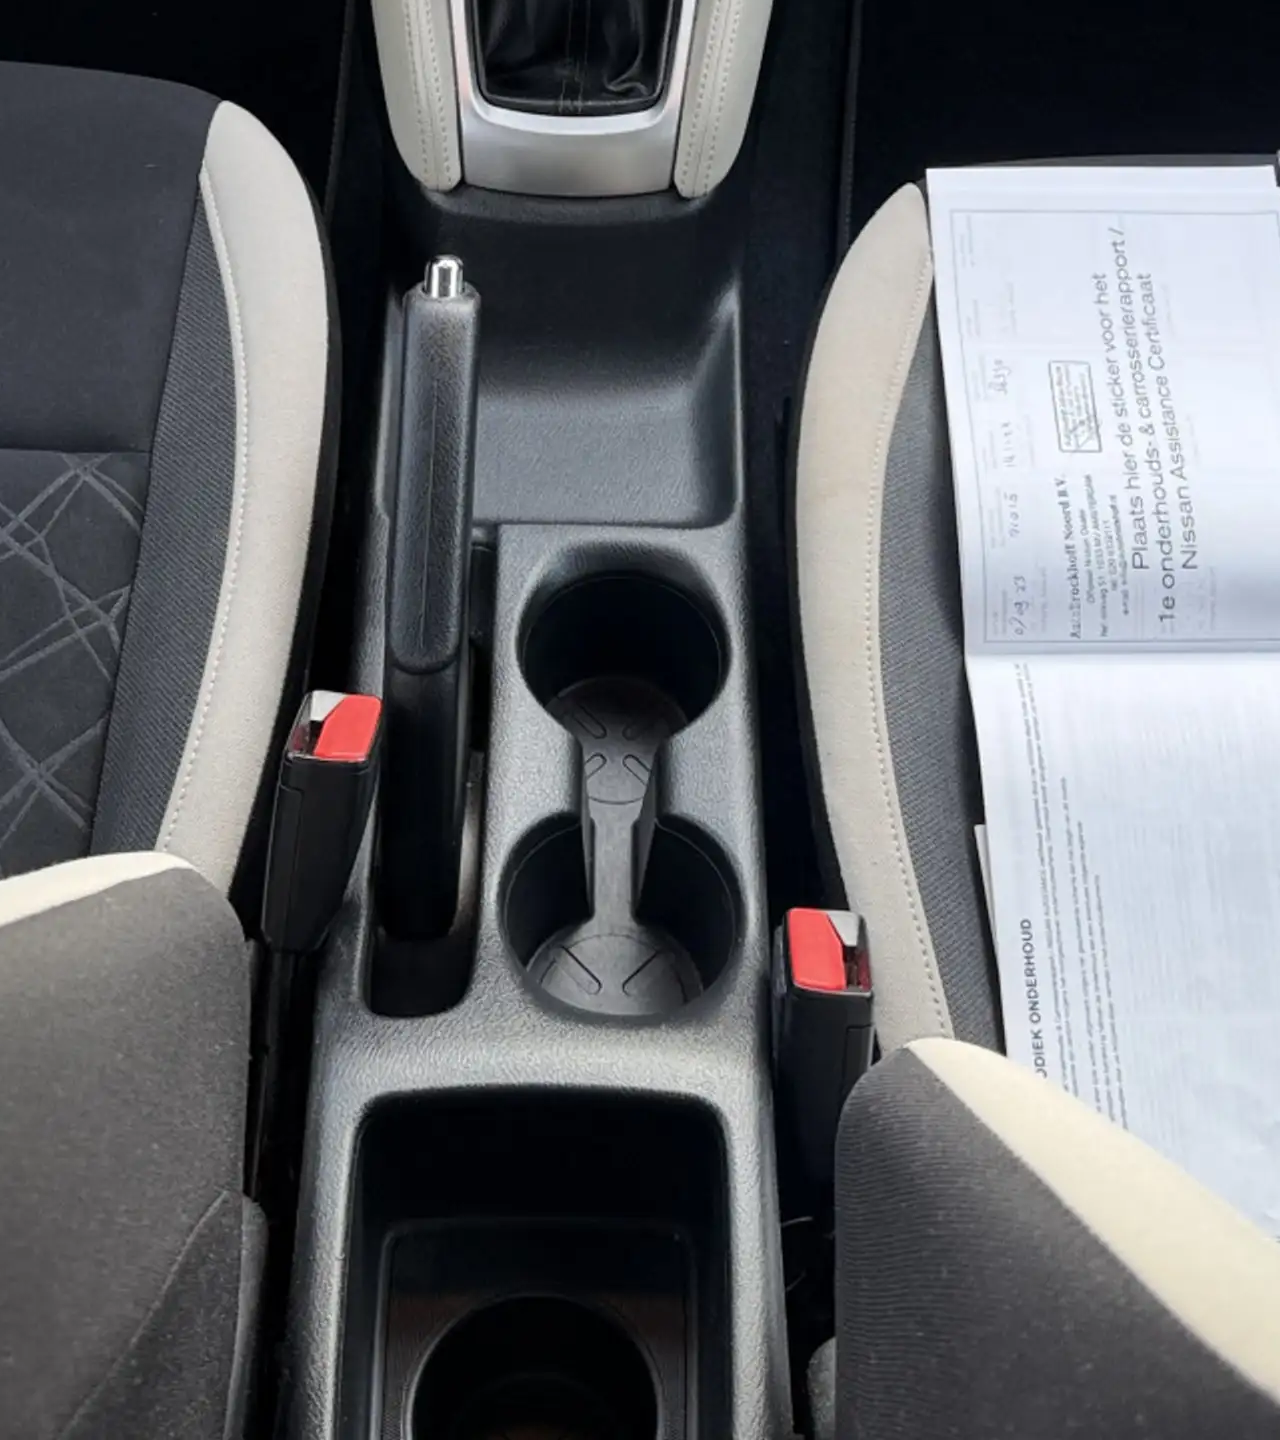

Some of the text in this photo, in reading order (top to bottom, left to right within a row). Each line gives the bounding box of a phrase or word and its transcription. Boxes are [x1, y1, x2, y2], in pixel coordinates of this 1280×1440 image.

[1111, 240, 1153, 420] carrosserierapport
[1092, 273, 1150, 569] Plaats hier de sticker voor het
[1136, 272, 1198, 570] Nissan Assistance Certificaat
[1138, 423, 1155, 437] &
[1143, 440, 1176, 590] onderhouds-
[1157, 595, 1176, 623] 1e
[1020, 919, 1042, 1024] ONDERHOUD
